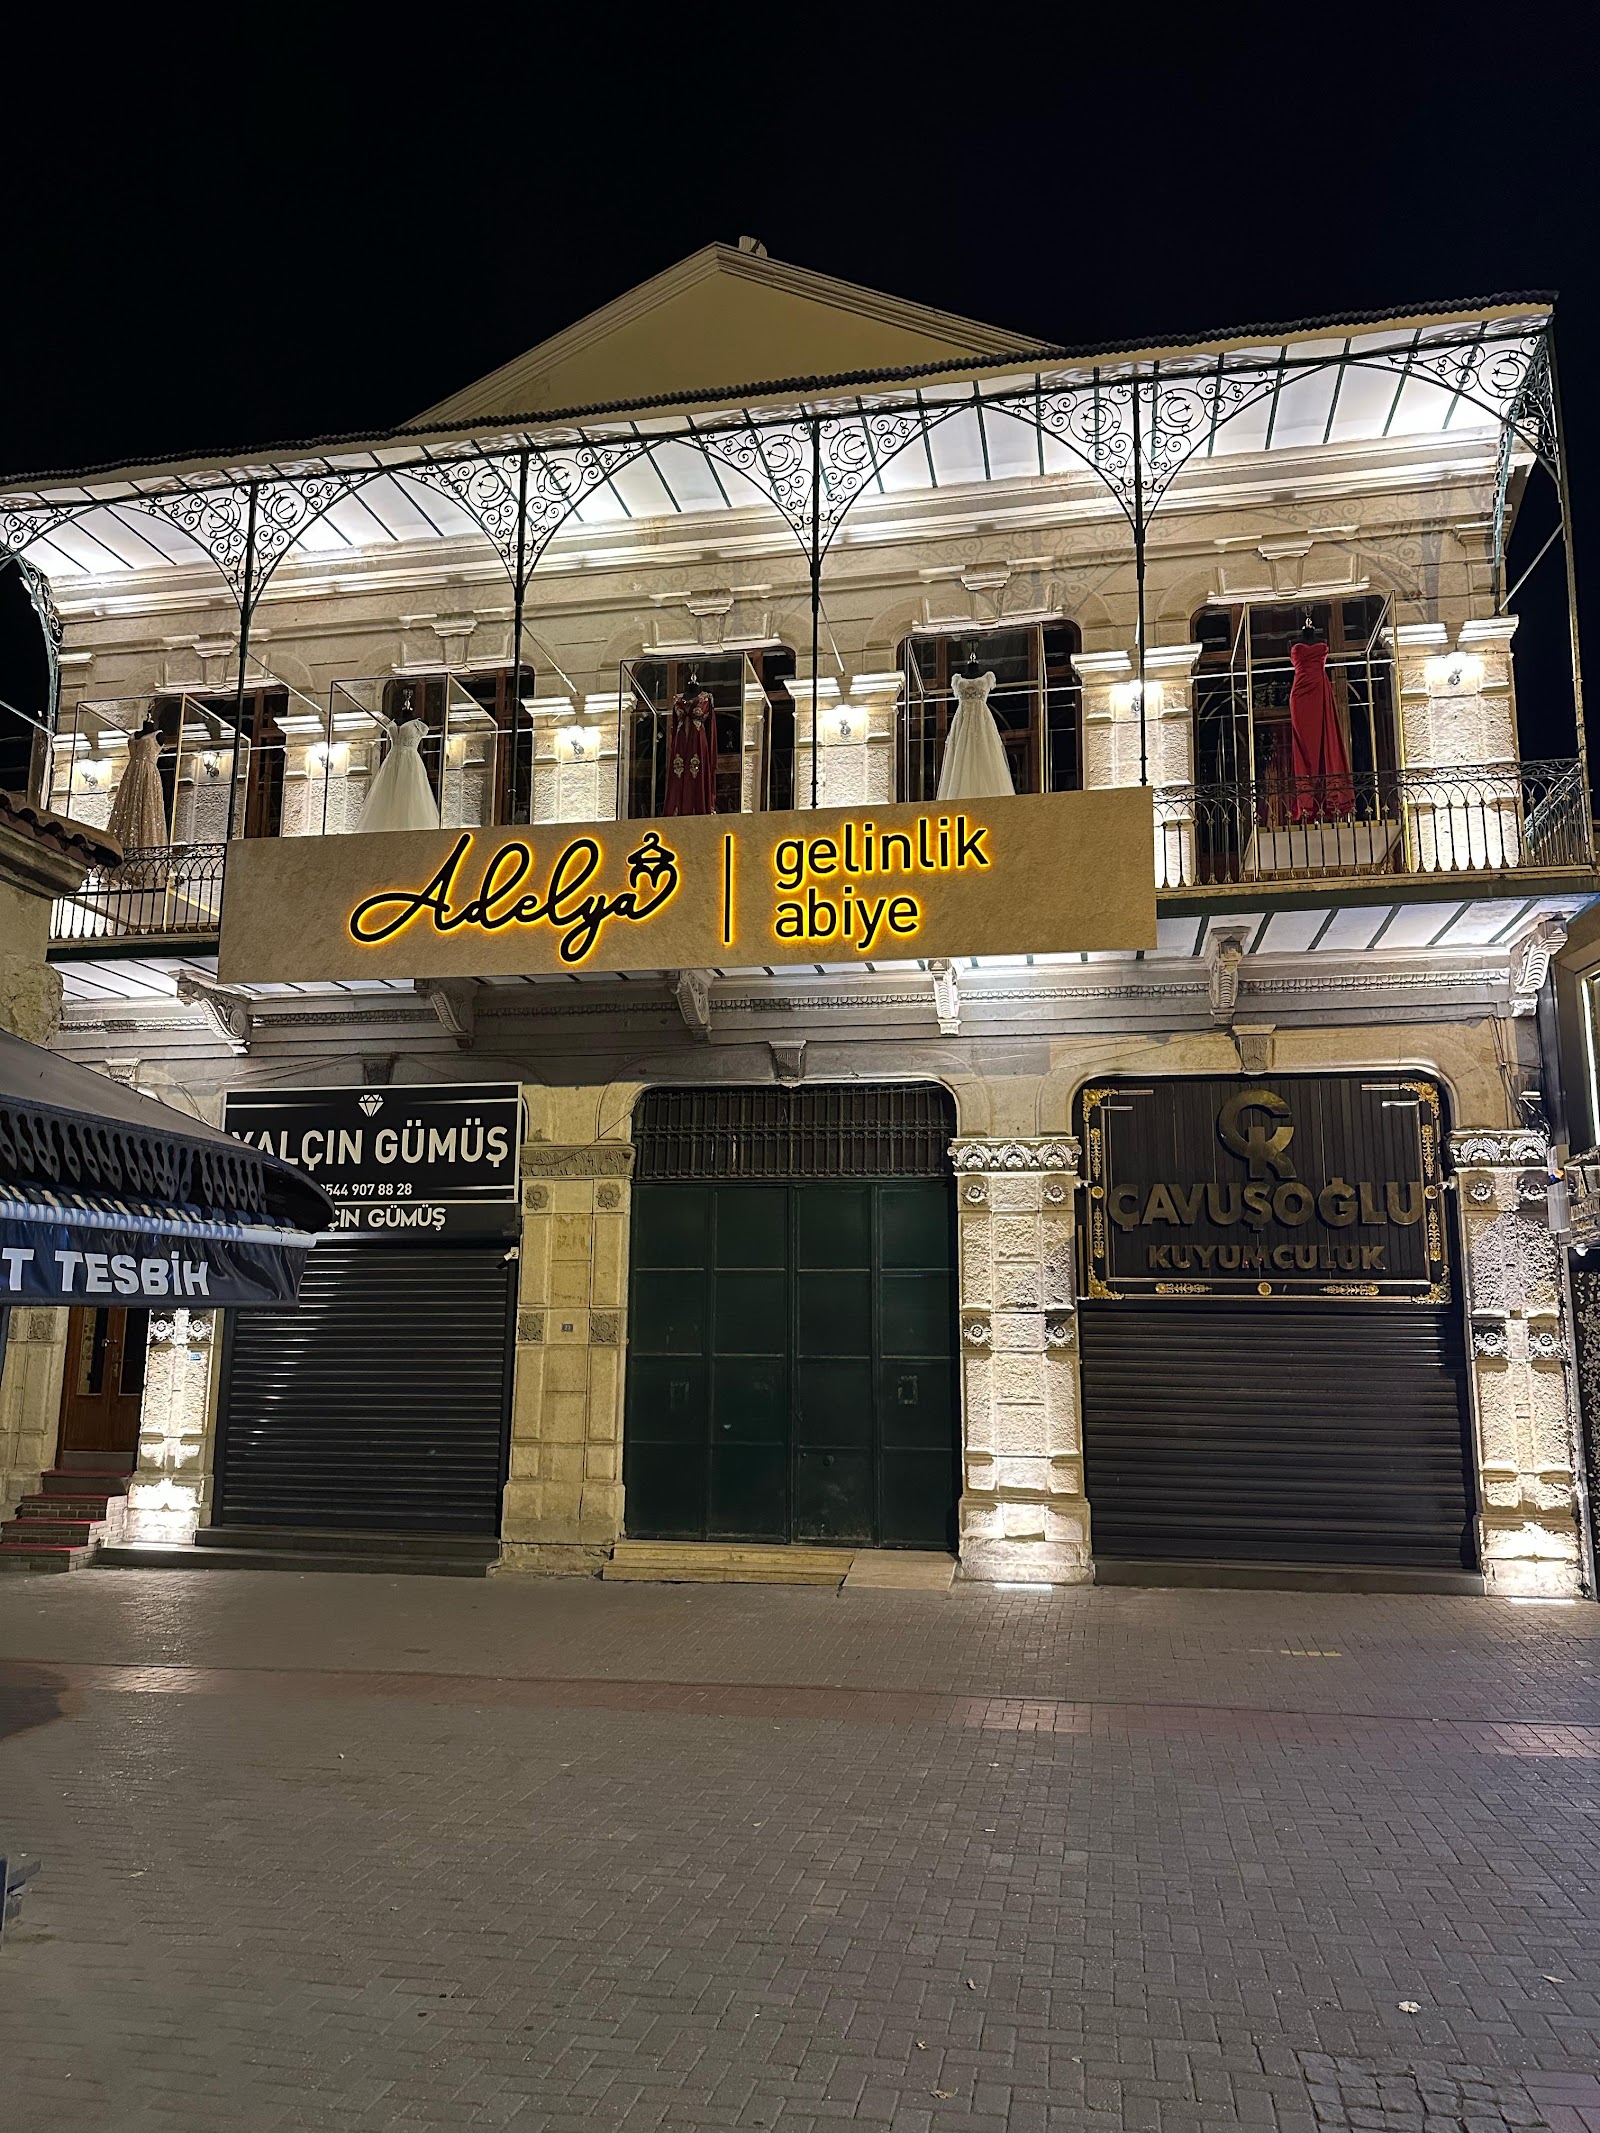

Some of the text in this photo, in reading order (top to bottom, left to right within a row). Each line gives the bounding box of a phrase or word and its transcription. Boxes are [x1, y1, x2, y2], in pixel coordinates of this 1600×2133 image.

[775, 816, 990, 890] gelinlik
[350, 832, 679, 963] Adelya
[775, 886, 919, 949] abiye
[374, 1117, 509, 1168] GÜMÜŞ
[351, 1183, 376, 1196] 907
[377, 1183, 394, 1196] 88
[396, 1183, 413, 1196] 28
[1107, 1177, 1424, 1232] ÇAVUŞOĞLU
[367, 1203, 447, 1231] GÜMÜŞ
[54, 1249, 210, 1296] TESBİH
[1148, 1244, 1388, 1271] KUYUMCULUK
